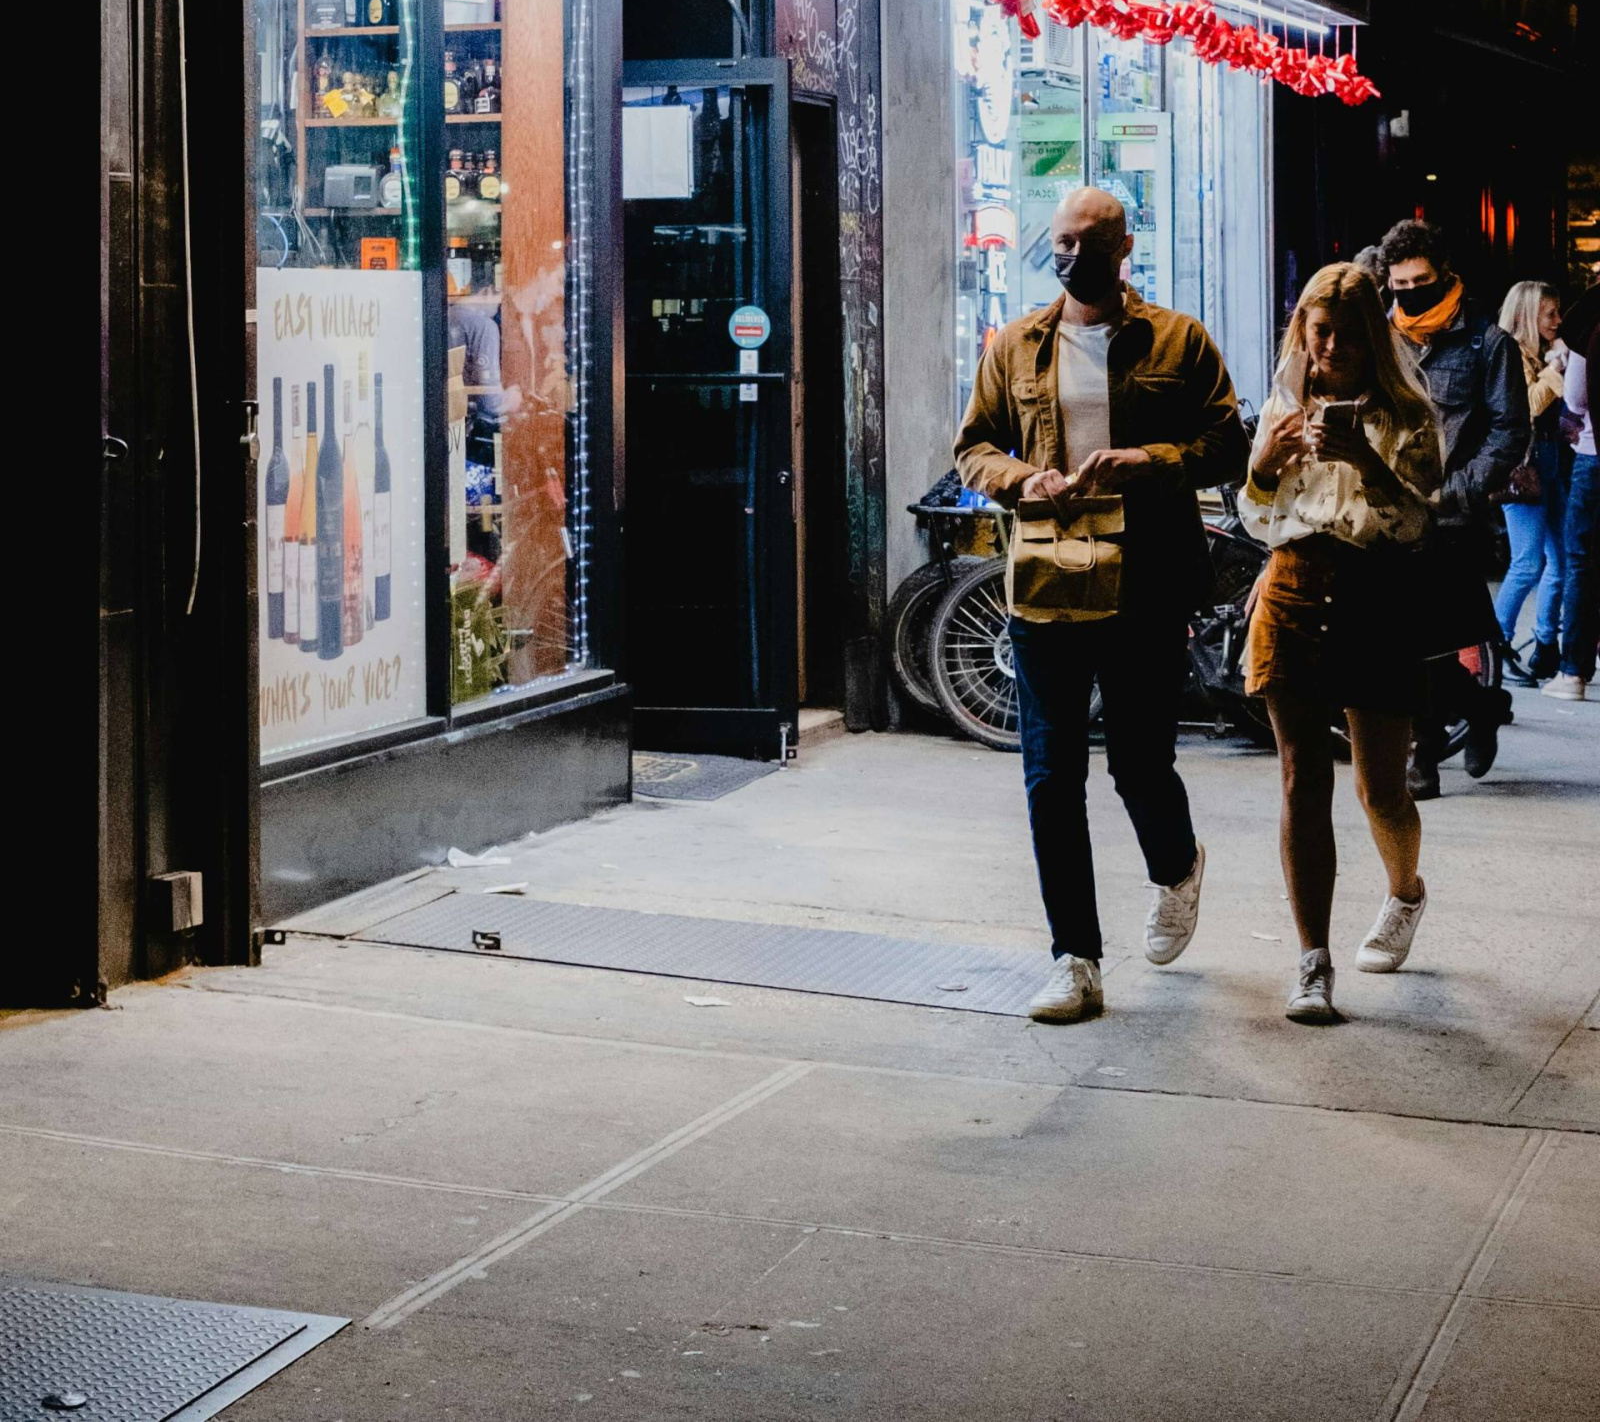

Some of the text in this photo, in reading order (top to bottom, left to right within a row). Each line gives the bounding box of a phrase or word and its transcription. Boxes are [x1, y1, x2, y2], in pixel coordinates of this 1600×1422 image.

[1134, 223, 1155, 231] PUSH
[274, 292, 312, 342] EAST
[319, 665, 356, 725] YOUR
